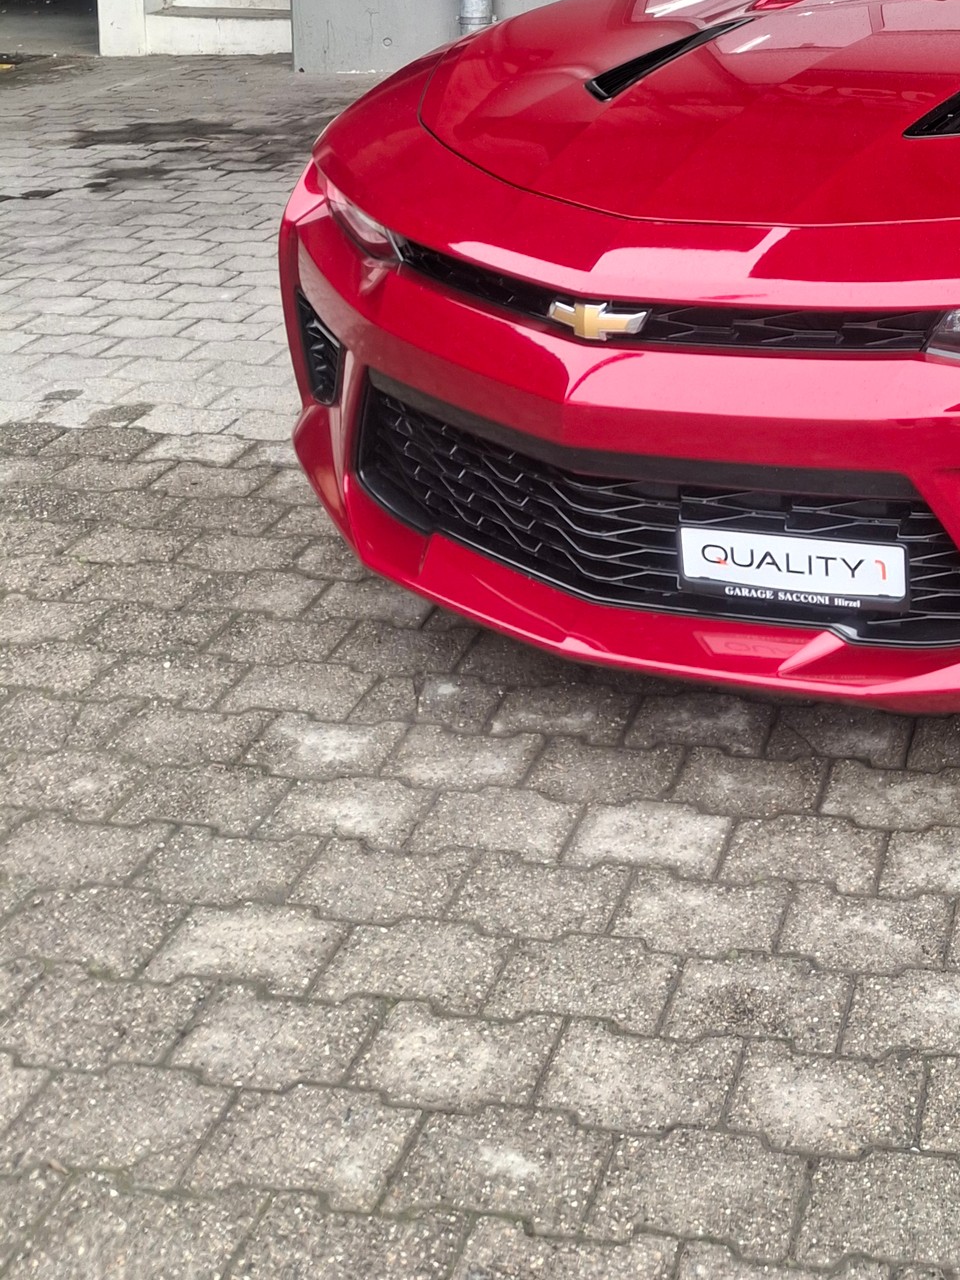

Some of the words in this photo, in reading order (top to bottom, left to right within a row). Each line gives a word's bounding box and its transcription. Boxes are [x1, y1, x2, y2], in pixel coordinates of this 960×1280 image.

[701, 543, 865, 579] QUALITY
[874, 559, 887, 581] 1
[725, 586, 774, 600] GARAGE
[778, 591, 830, 606] SACCONI
[834, 597, 861, 609] Hirzel
